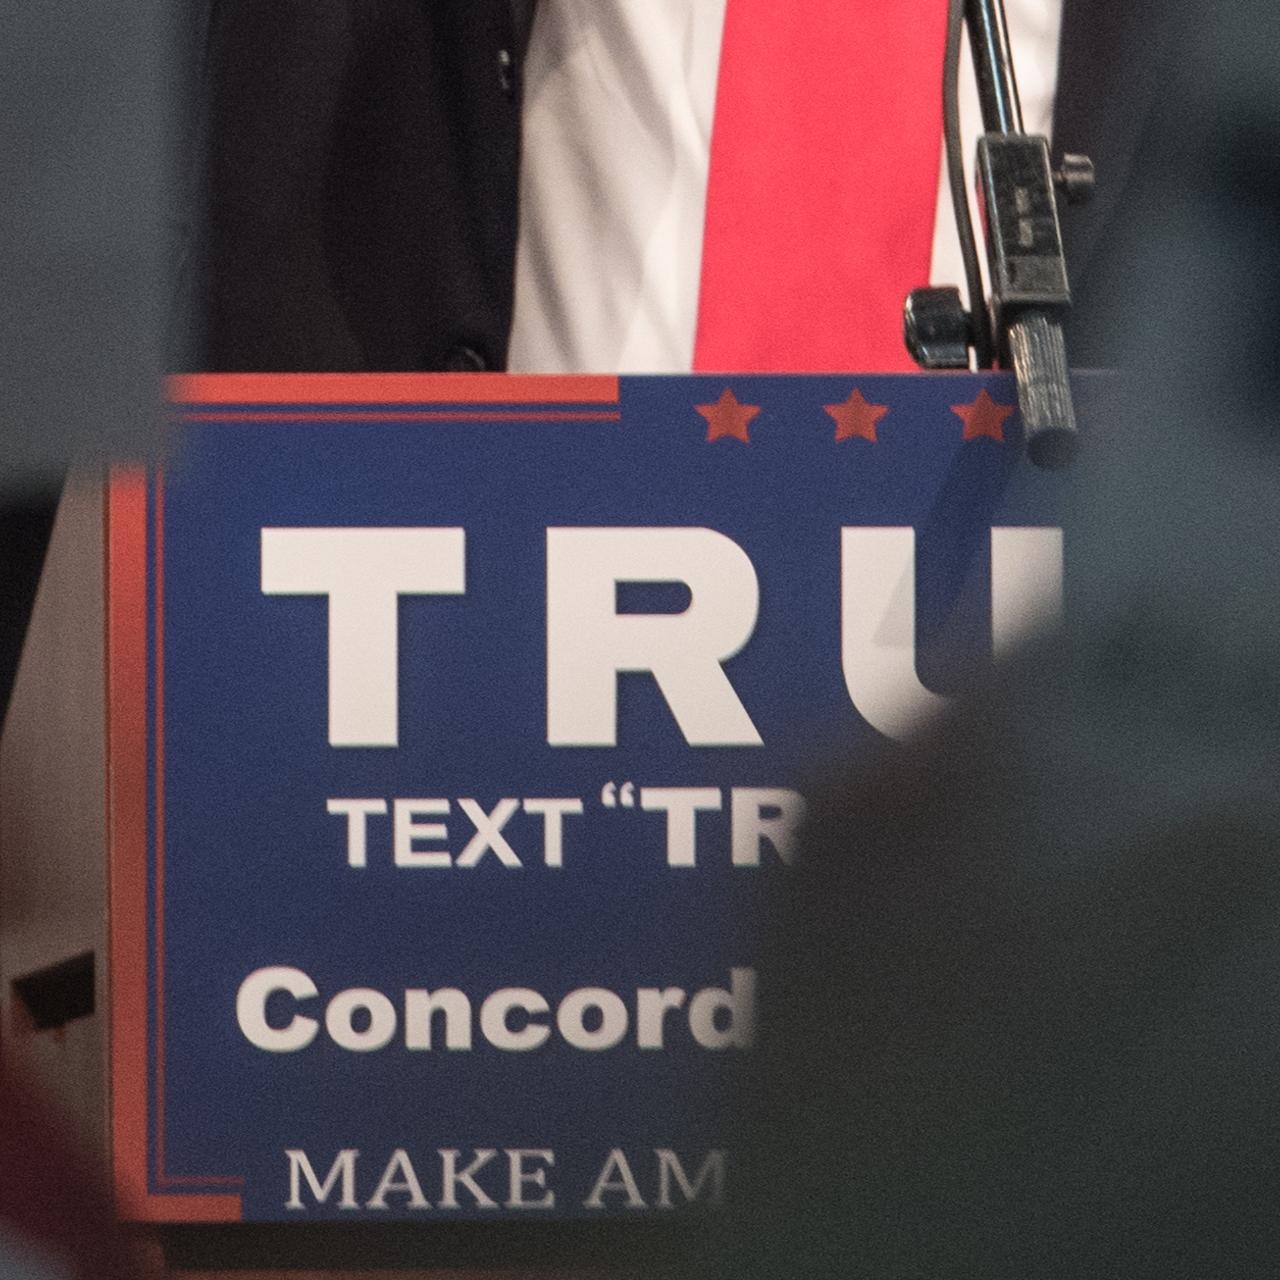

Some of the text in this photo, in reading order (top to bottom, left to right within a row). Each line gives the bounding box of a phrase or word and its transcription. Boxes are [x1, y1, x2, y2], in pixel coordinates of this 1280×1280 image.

[260, 526, 1064, 747] TRU
[326, 798, 584, 868] TEXT
[235, 965, 754, 1053] Concord
[284, 1147, 728, 1210] MAKE AM
